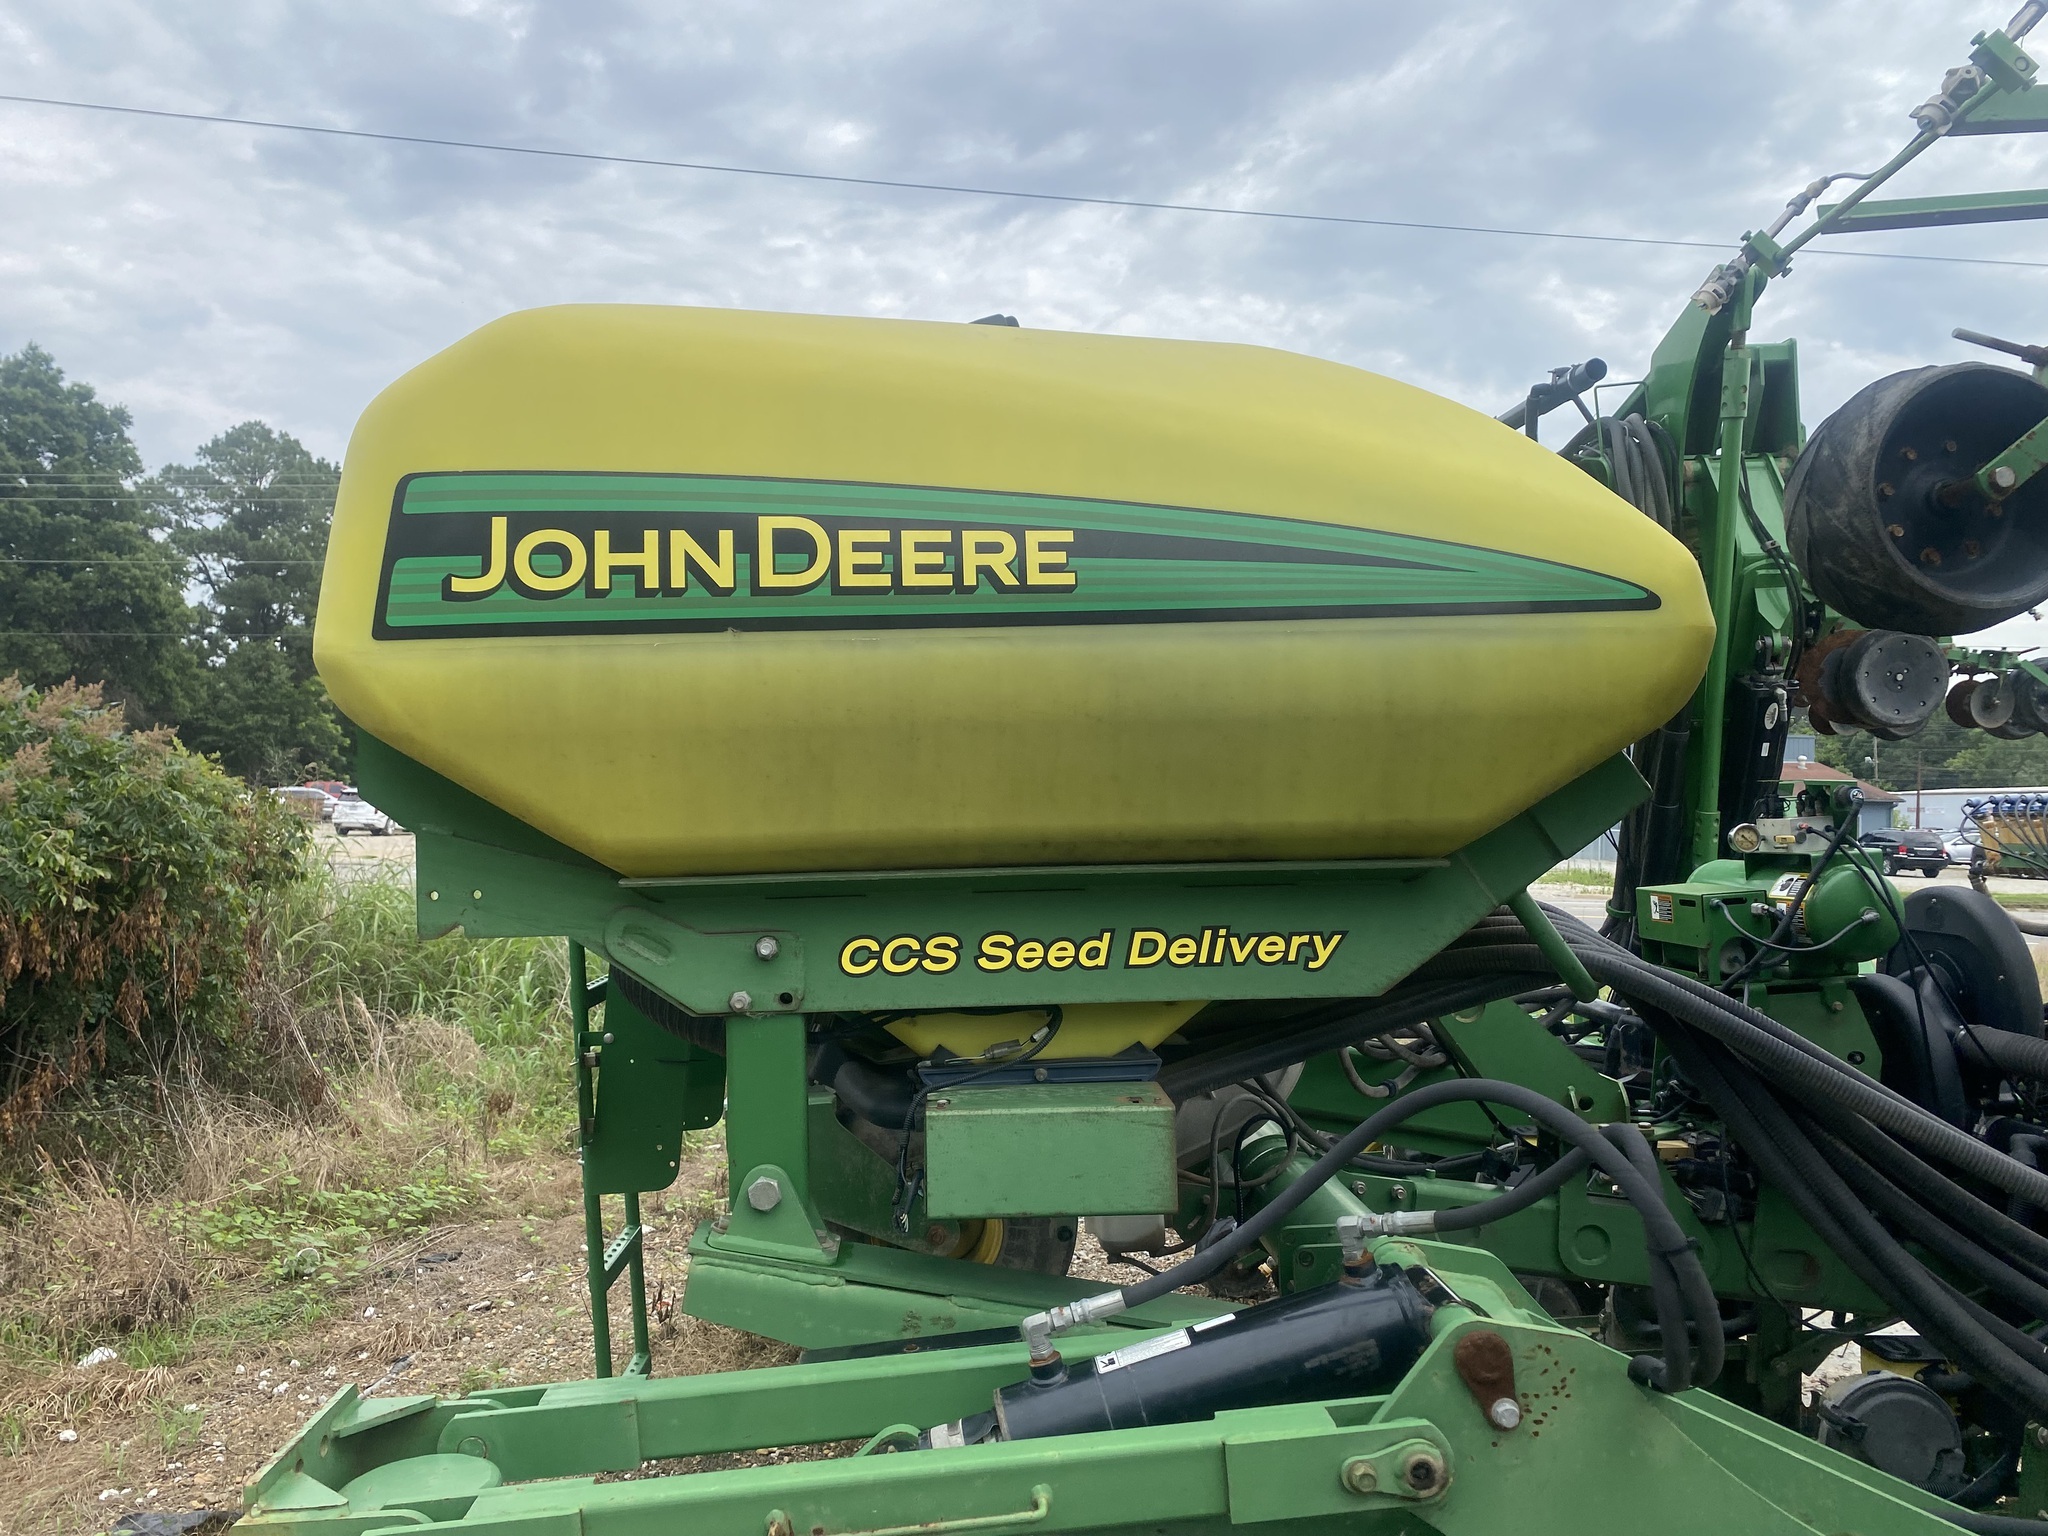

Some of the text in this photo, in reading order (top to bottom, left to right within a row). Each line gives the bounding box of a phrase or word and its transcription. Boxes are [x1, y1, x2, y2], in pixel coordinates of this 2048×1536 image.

[448, 515, 1076, 595] JOHN DEERE
[839, 927, 1343, 975] CCS Seed Delivery
